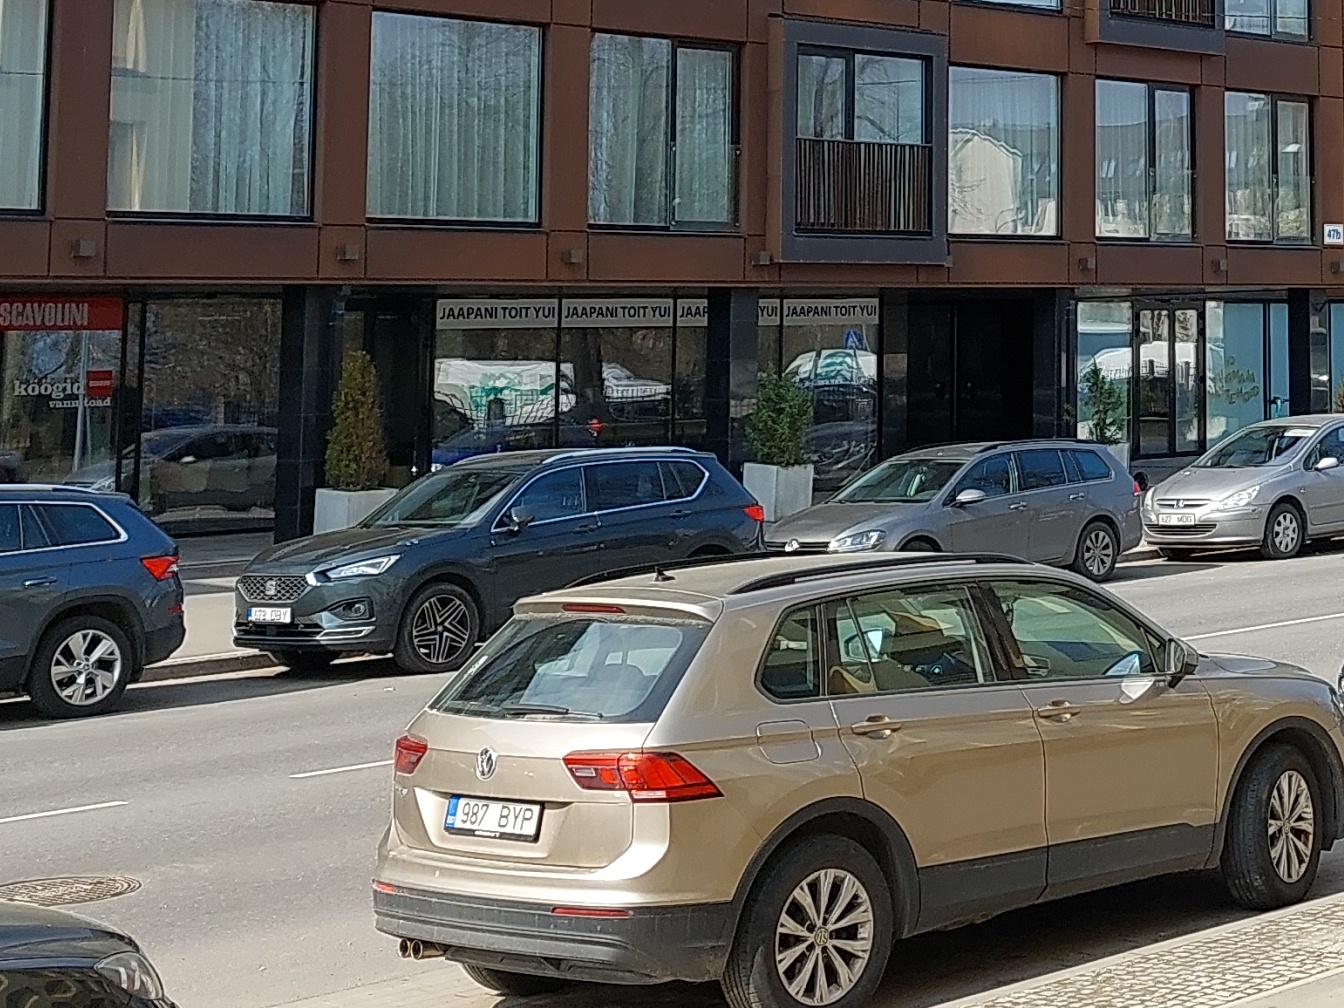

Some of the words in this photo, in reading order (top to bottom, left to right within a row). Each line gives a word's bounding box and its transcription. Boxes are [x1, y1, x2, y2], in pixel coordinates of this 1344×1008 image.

[0, 302, 89, 327] SCAVOLINI
[440, 306, 498, 320] JAAPANI
[500, 306, 531, 320] TOIT
[533, 306, 555, 319] YUI
[564, 305, 618, 319] JAAPANI
[619, 305, 649, 319] TOIT
[651, 305, 671, 318] YUI
[758, 305, 778, 318] YUI
[785, 305, 831, 318] JAAPANI
[833, 305, 858, 318] TOIT
[858, 304, 877, 317] YUI
[13, 379, 86, 399] köögid
[48, 397, 111, 409] vanntoad
[461, 801, 490, 826] 987
[497, 804, 534, 831] BYP
